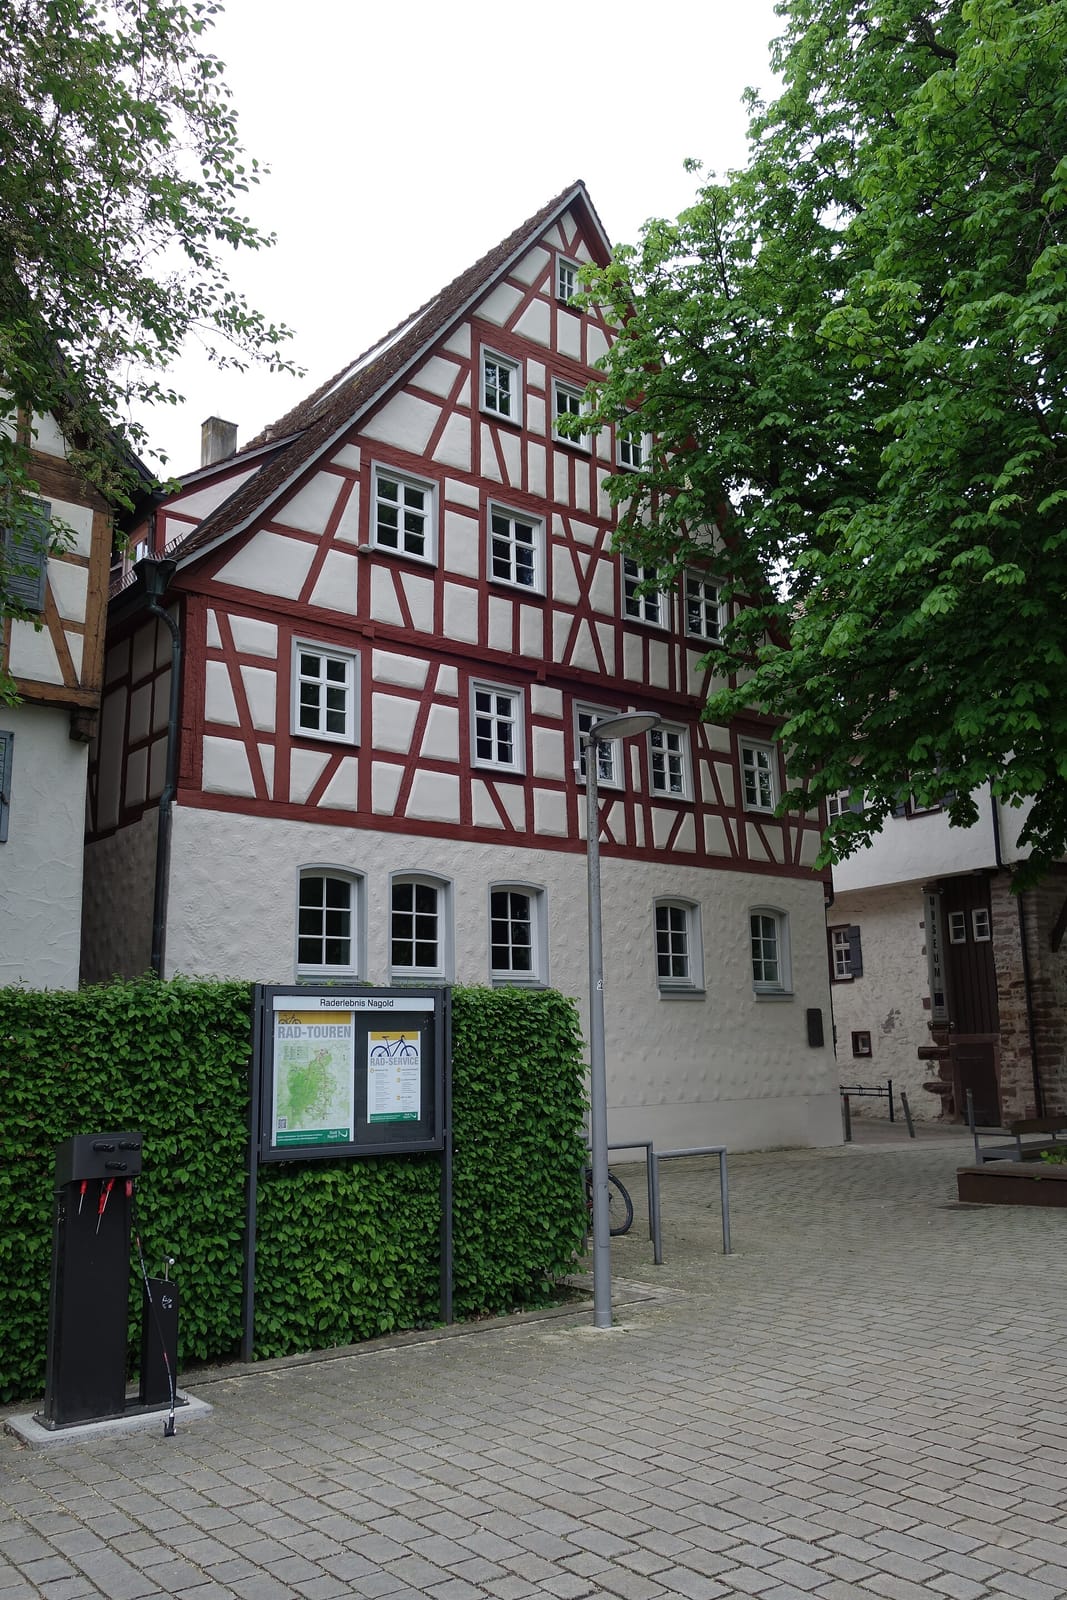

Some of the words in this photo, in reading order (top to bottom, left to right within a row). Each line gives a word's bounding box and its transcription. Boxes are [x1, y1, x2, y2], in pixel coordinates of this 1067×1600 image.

[320, 999, 365, 1007] Raderlebnis
[367, 1000, 394, 1008] Nagold
[277, 1026, 351, 1039] RAD-TOUREN
[370, 1057, 419, 1066] RAD-SERVICE
